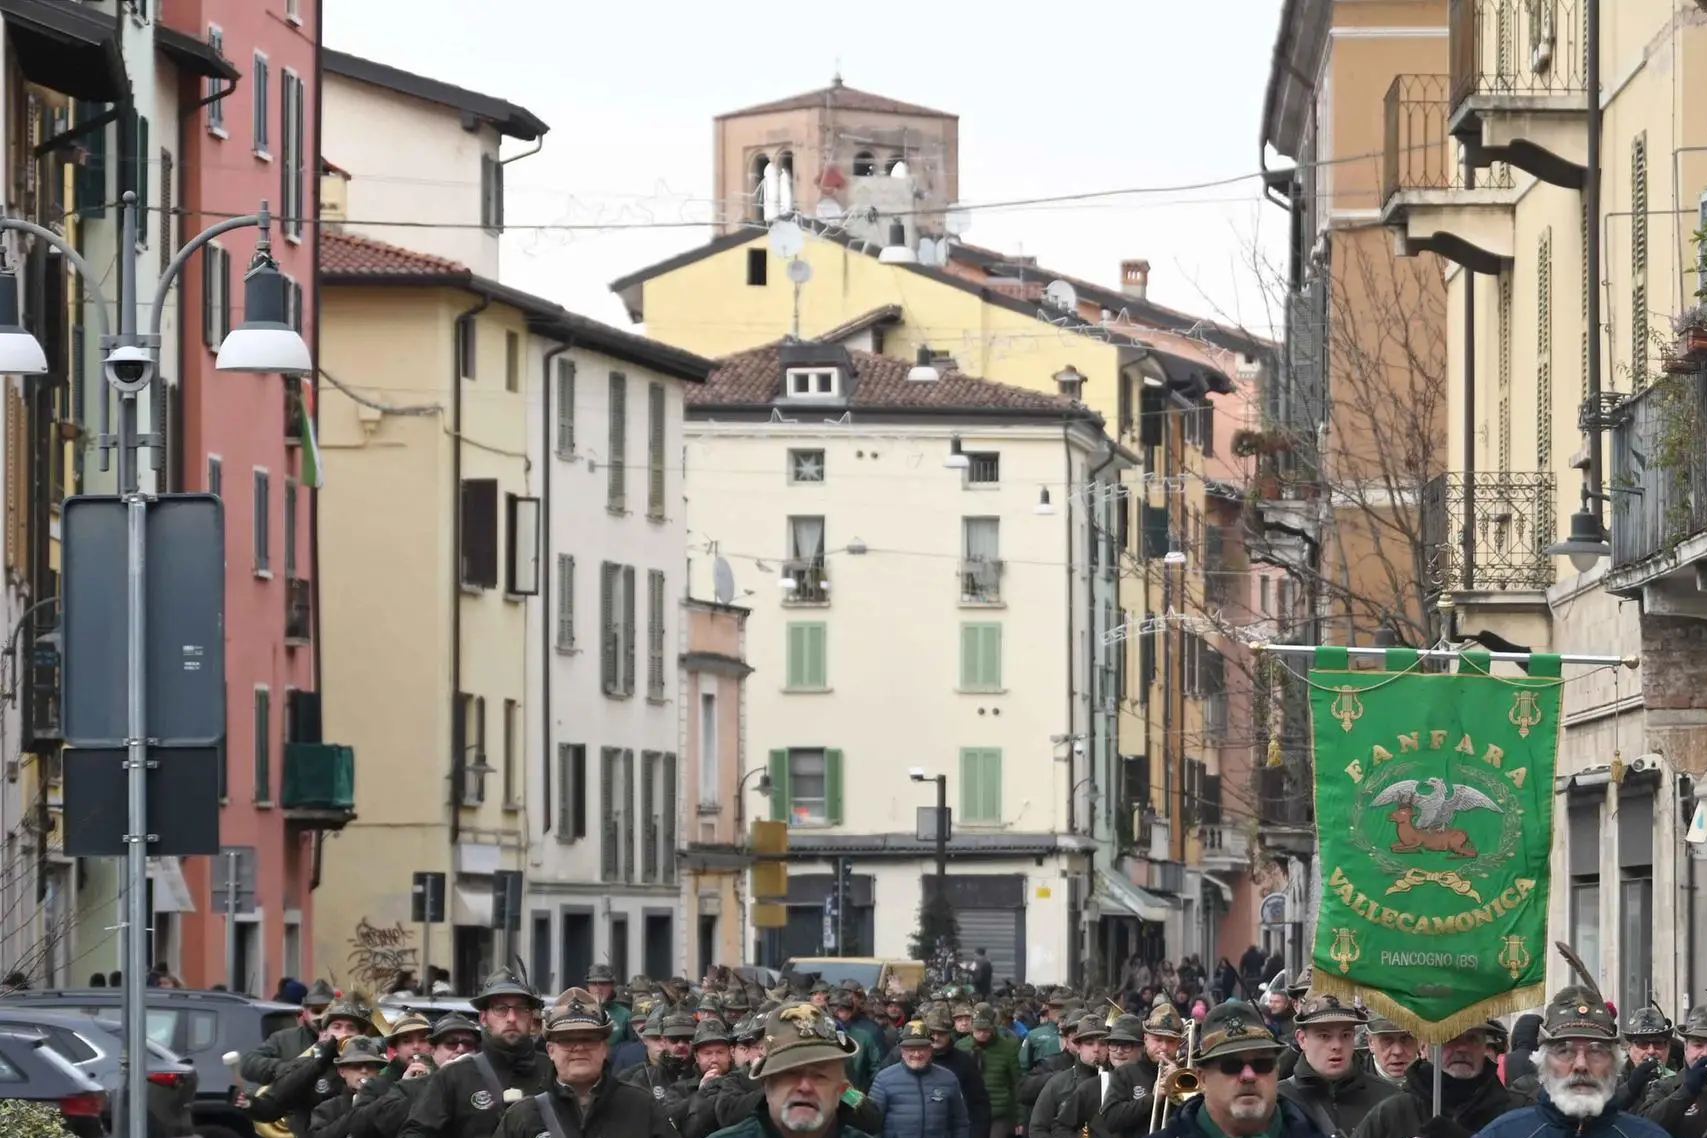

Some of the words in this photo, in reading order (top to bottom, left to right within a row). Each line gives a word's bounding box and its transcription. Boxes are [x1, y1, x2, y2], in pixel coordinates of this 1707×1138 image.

[1343, 729, 1527, 789] FANFARA
[1328, 866, 1537, 934] VALLECAMONICA
[1381, 950, 1452, 967] PIANCOGNO
[1456, 953, 1479, 970] (BS)
